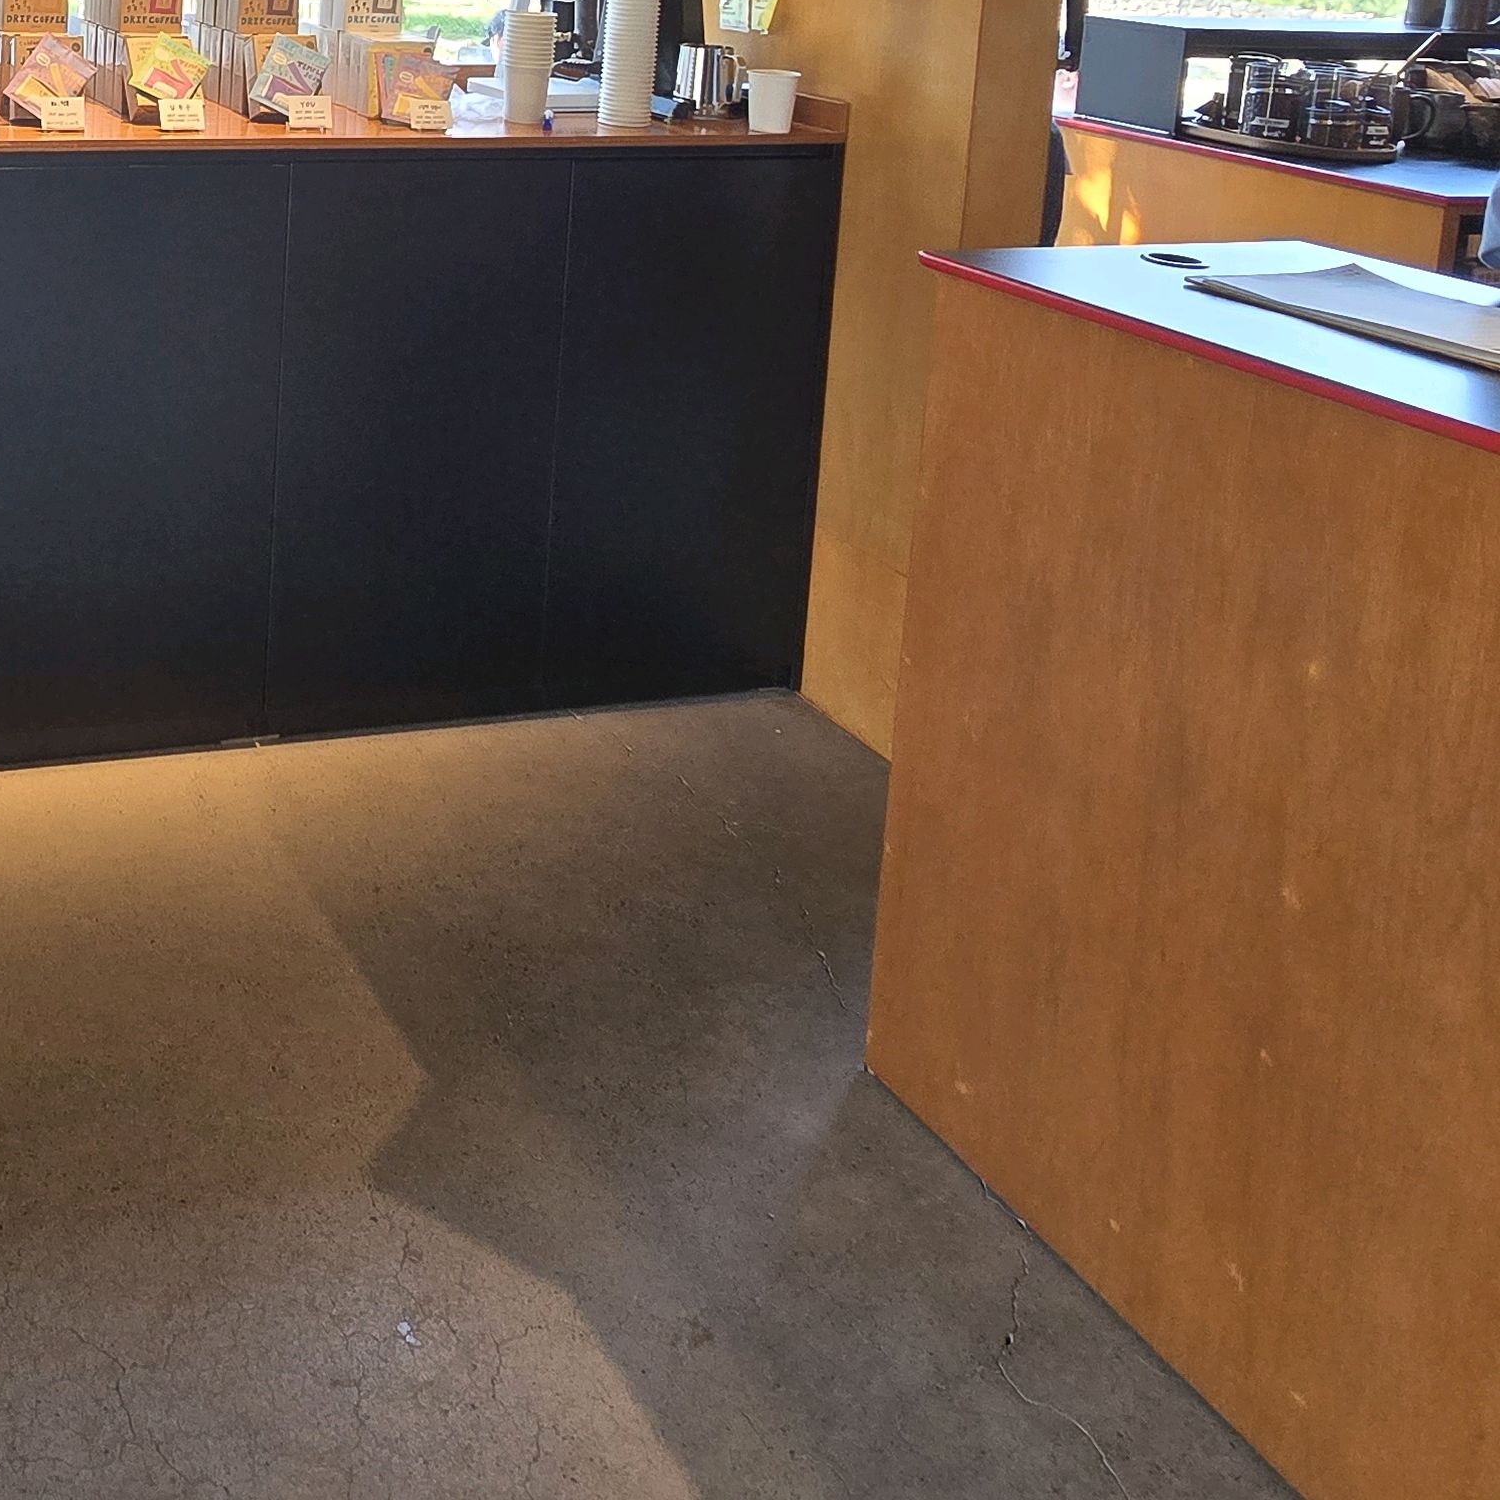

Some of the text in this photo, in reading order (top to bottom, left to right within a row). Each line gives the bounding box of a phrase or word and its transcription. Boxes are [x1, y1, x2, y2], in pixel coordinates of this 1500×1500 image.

[6, 14, 32, 23] DRIP
[123, 16, 148, 24] DRIP
[241, 17, 265, 25] DRIP
[348, 16, 370, 24] DRIP
